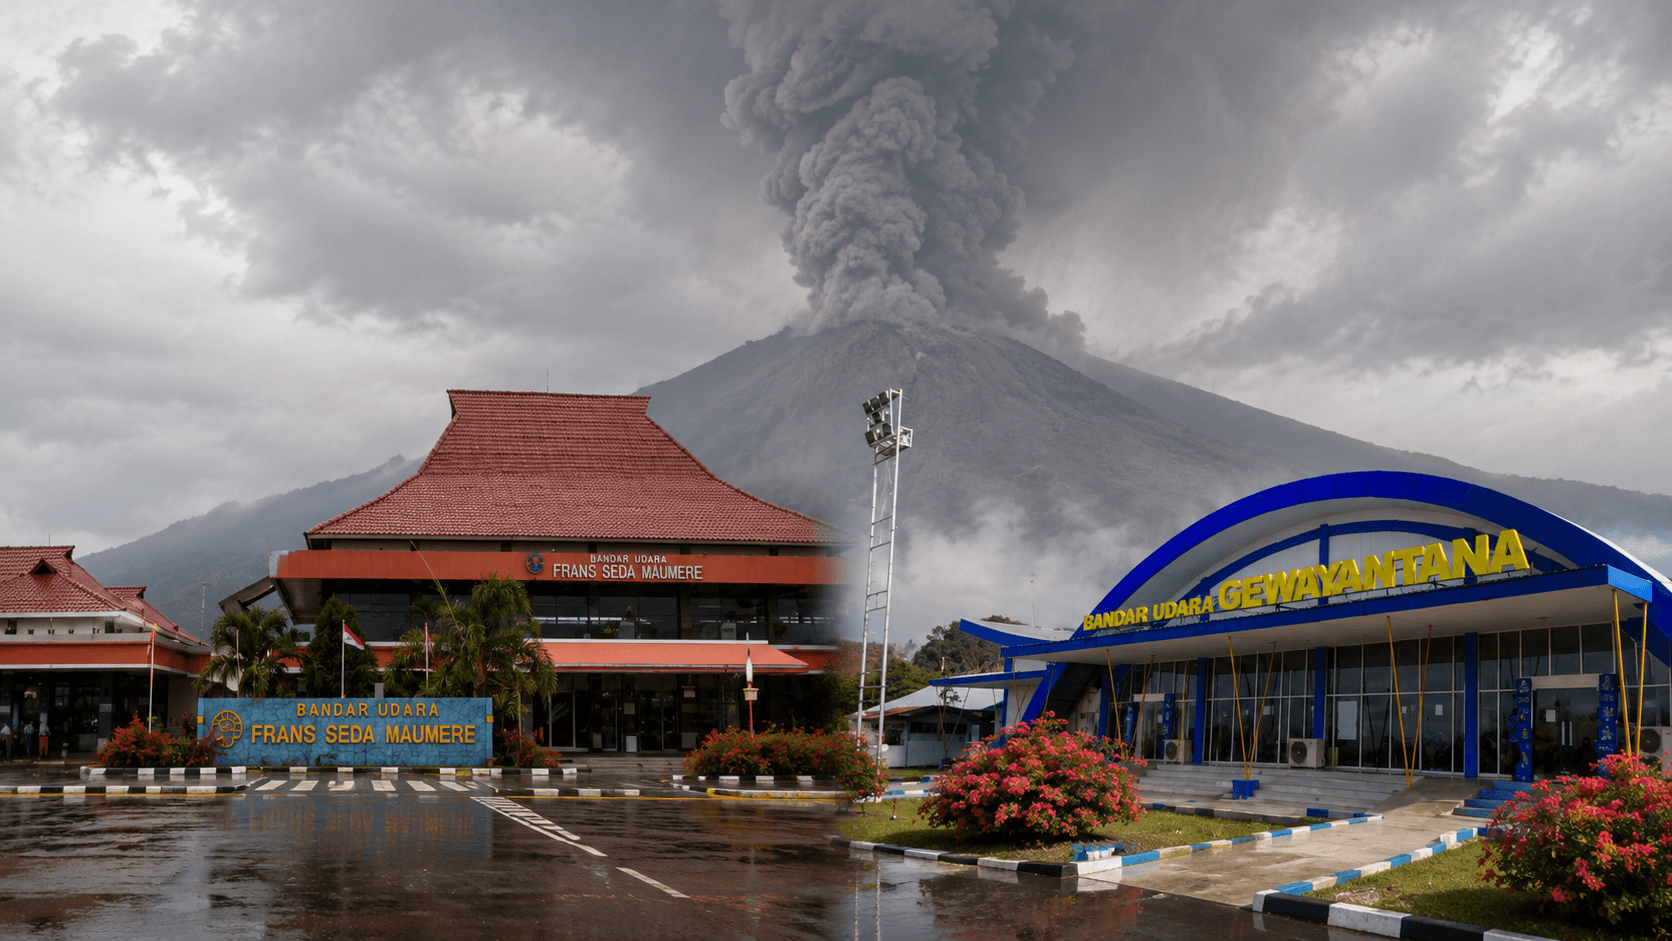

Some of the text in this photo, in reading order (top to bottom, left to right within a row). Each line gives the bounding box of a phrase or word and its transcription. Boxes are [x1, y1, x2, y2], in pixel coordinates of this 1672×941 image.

[590, 554, 629, 564] BANDAR
[553, 563, 703, 580] FRANS SEDA MAUMERE
[1083, 528, 1531, 632] BANDAR UDARA GEWAYANTANA
[296, 702, 440, 717] BANDAR UDARA
[251, 724, 476, 744] FRANS SEDA MAUMERE
